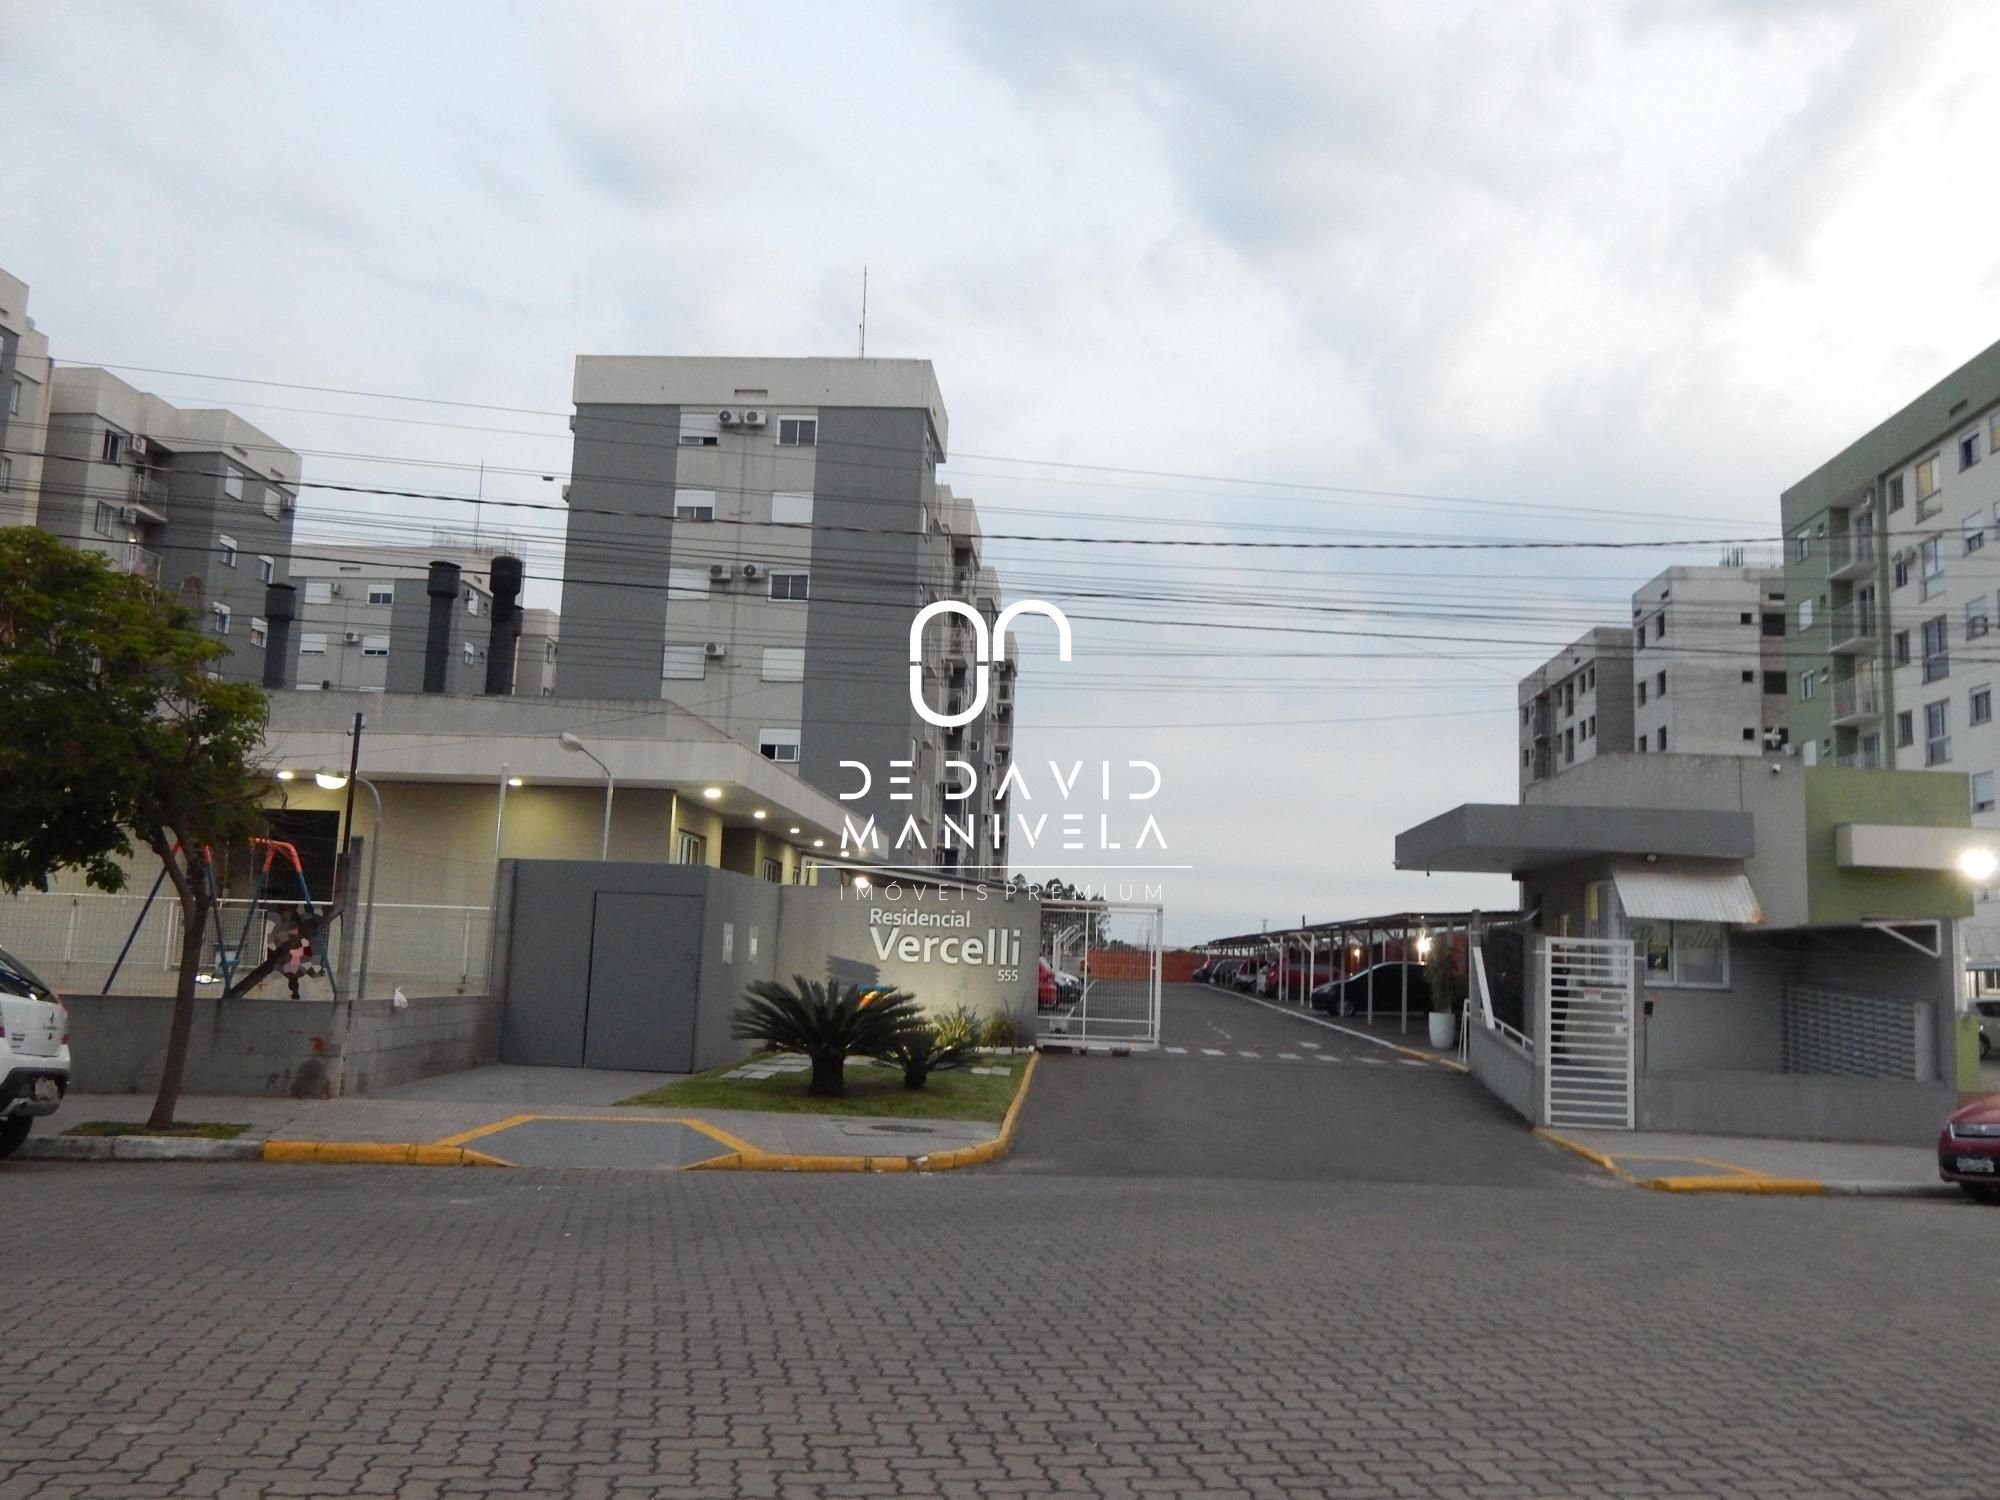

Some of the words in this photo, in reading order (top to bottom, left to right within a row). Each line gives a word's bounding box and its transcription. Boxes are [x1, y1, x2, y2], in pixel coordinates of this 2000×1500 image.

[869, 907, 971, 928] Residencial
[869, 926, 1021, 966] Vercelli
[997, 969, 1019, 982] 555
